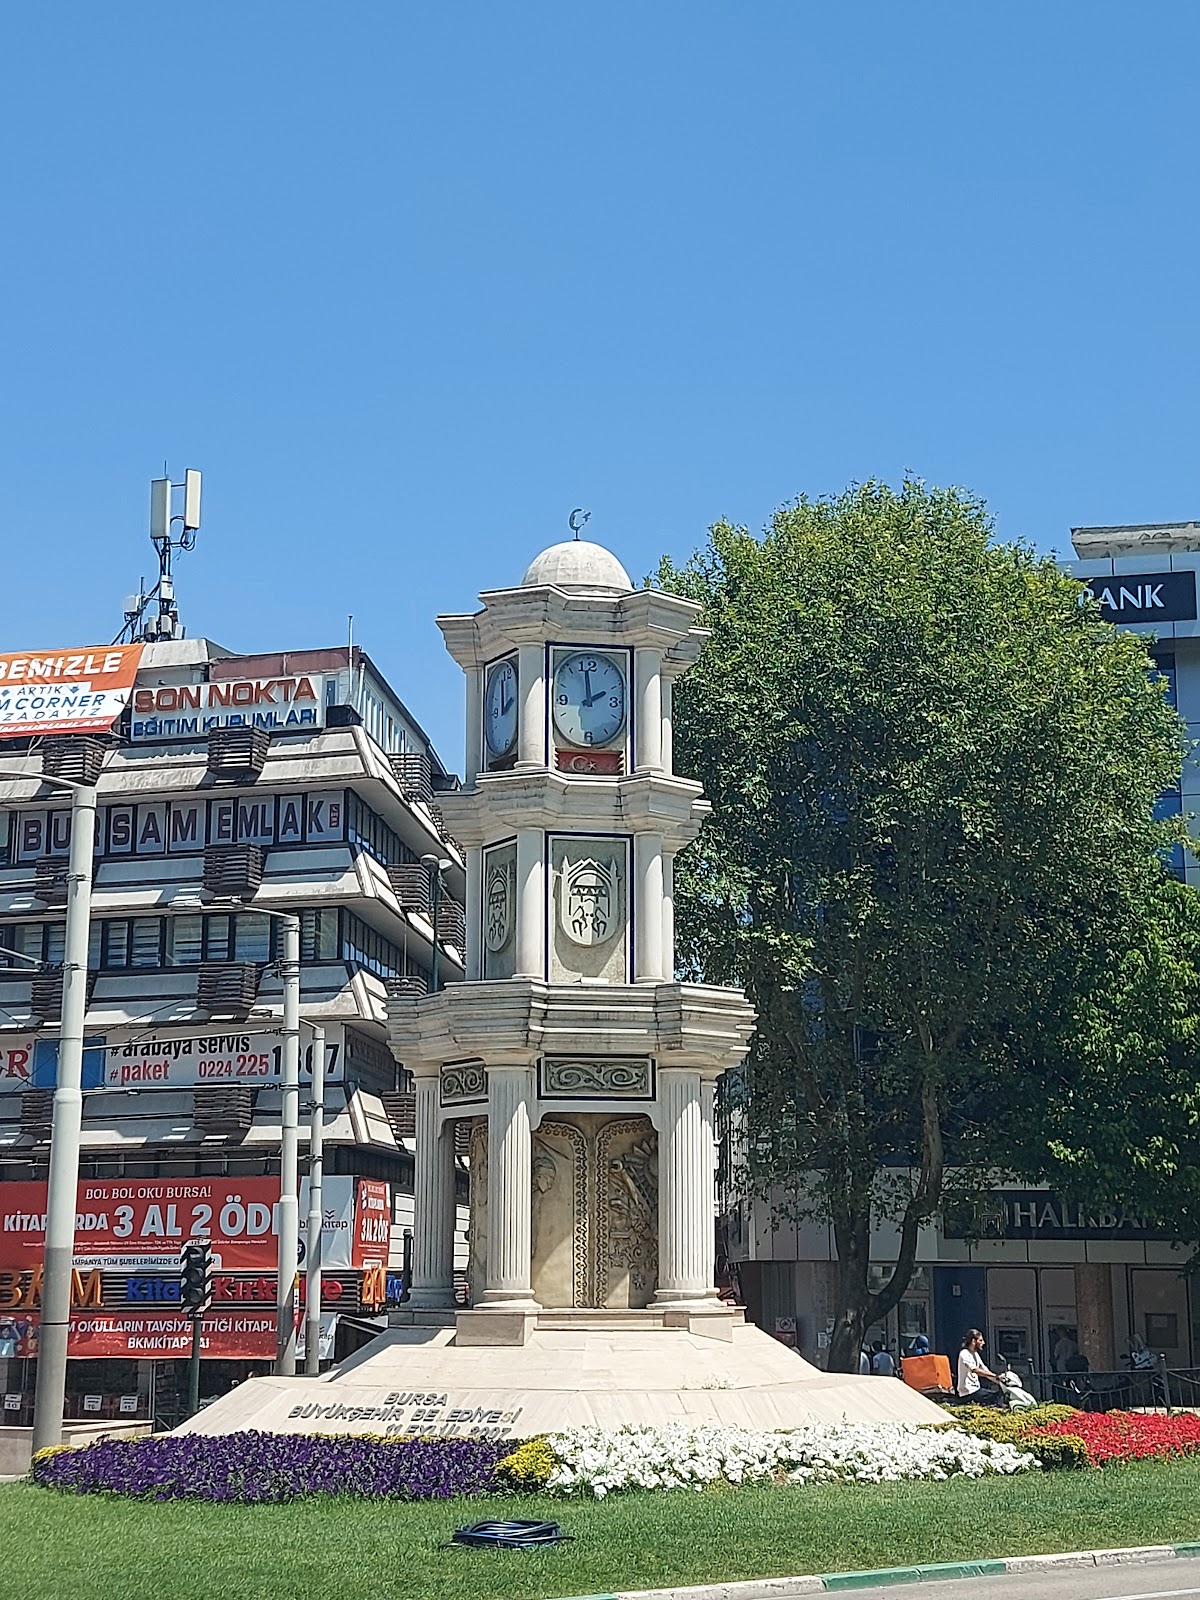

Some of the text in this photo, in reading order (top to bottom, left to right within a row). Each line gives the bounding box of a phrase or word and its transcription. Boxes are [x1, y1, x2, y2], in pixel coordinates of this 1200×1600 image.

[578, 660, 597, 673] 12
[17, 686, 64, 697] ARTIK
[134, 677, 318, 713] SON NOKTA
[15, 694, 106, 710] CORNER
[558, 694, 569, 706] 9
[609, 697, 619, 708] 3
[584, 731, 594, 742] 6
[217, 801, 325, 839] EMLAK
[199, 1060, 233, 1078] 0224
[236, 1053, 269, 1077] 225
[85, 1185, 212, 1200] BOL BOL OKU BURSA!
[113, 1205, 134, 1237] 3
[140, 1204, 182, 1237] AL
[190, 1203, 212, 1236] 2
[126, 1277, 181, 1301] Kita
[78, 1320, 144, 1333] OKULLARIN
[146, 1317, 191, 1333] TAVSİYE
[200, 1316, 233, 1333] TTİĞİ
[234, 1317, 278, 1333] KİTAPL
[384, 1391, 449, 1407] BURSA
[288, 1403, 523, 1425] BÜYÜKŞEHİR BELEDİYESİ
